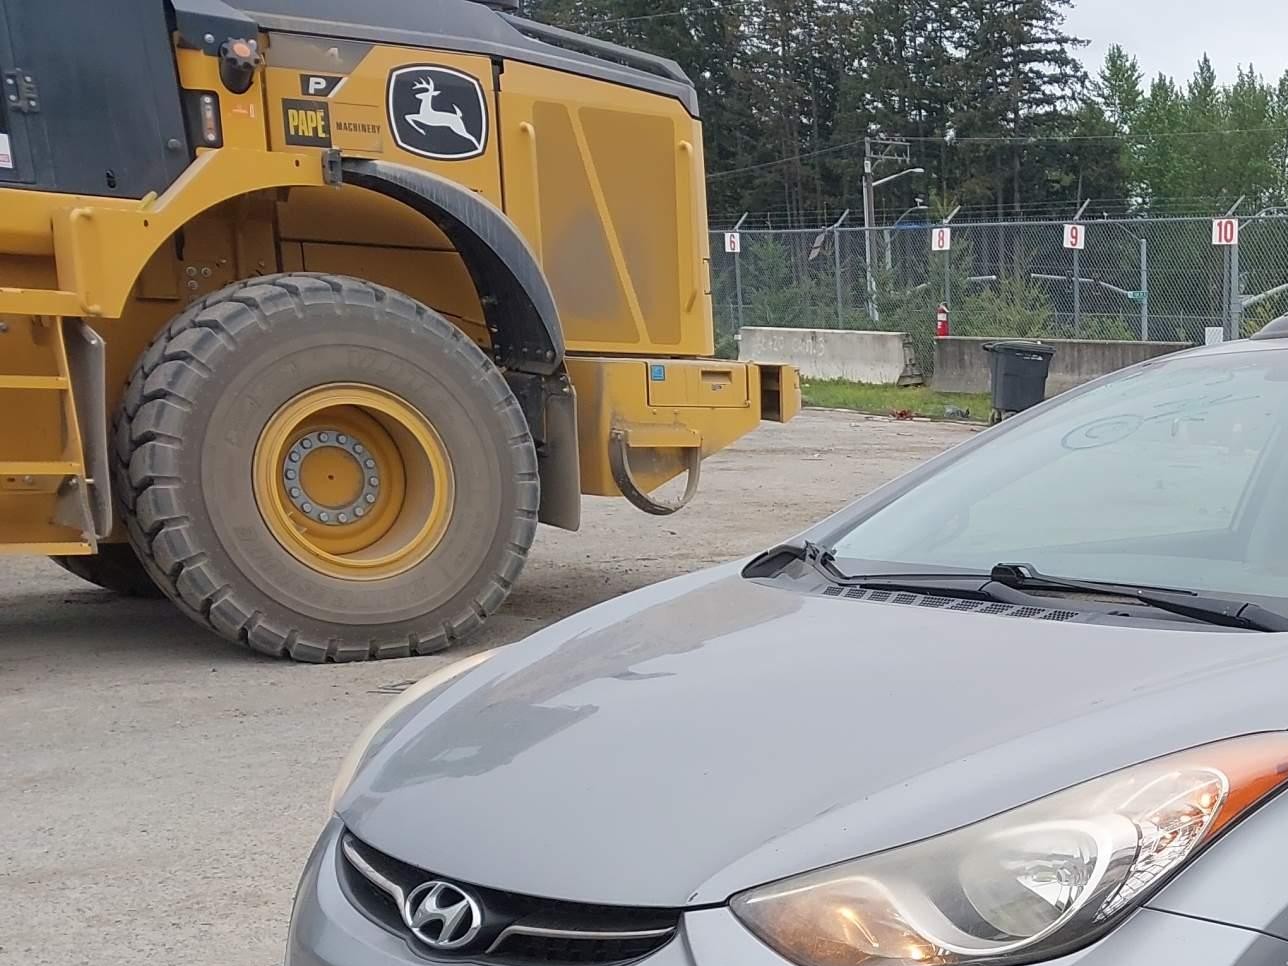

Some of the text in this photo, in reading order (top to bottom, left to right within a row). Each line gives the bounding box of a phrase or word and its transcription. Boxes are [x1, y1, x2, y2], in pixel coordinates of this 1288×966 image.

[308, 77, 326, 94] P
[335, 121, 381, 135] MACHINERY
[937, 230, 945, 249] 8
[1069, 226, 1079, 247] 9
[1216, 220, 1234, 243] 10
[729, 234, 737, 251] 6
